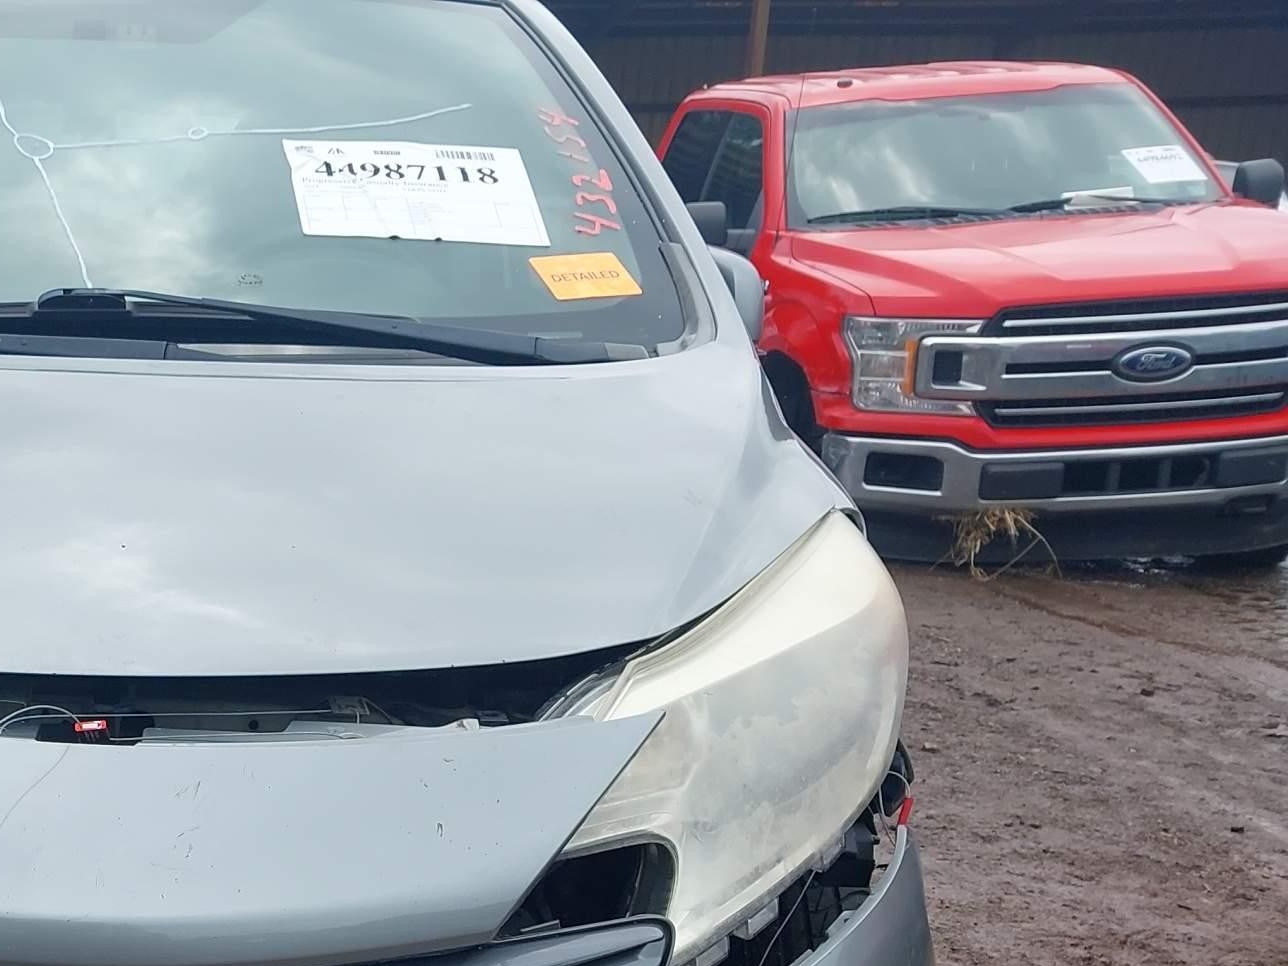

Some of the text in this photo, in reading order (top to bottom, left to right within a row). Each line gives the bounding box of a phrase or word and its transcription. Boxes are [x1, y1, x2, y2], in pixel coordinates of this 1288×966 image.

[314, 160, 499, 185] 44987118
[572, 168, 622, 236] 432
[550, 269, 620, 284] DETAILED
[1136, 352, 1178, 371] Ford
